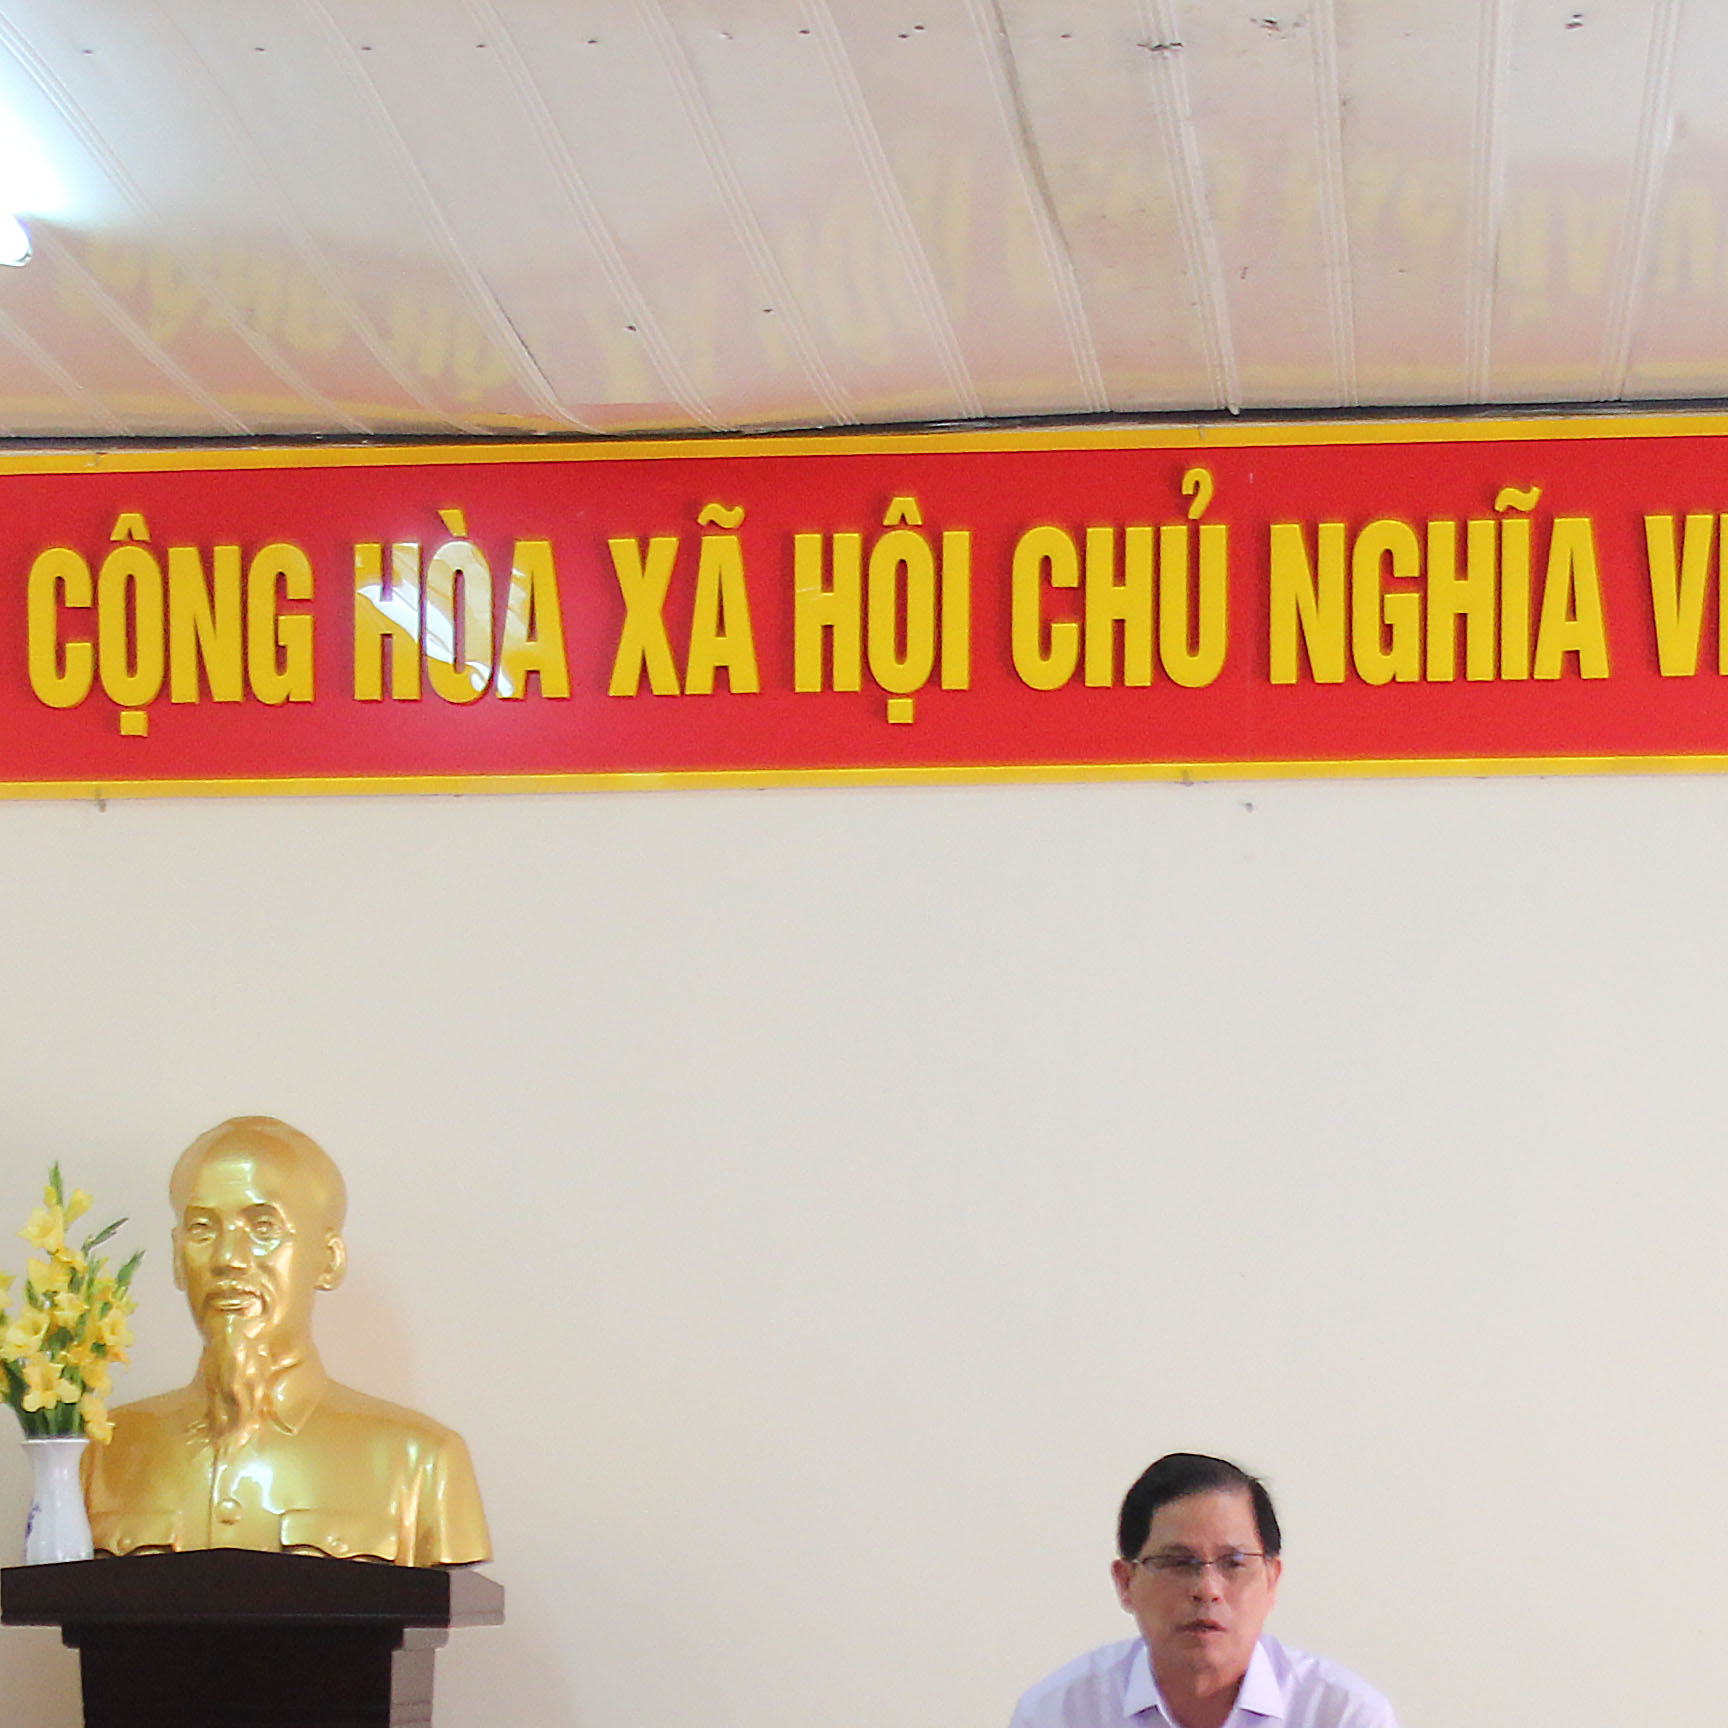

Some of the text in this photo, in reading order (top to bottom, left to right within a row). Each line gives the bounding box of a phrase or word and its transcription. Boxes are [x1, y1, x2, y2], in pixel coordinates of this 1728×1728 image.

[26, 511, 315, 738] CỘNG
[352, 507, 572, 702] HÒA
[606, 501, 761, 698] XÃ
[793, 495, 973, 725] HỘI
[1010, 466, 1231, 692] CHỦ
[1268, 484, 1612, 687] NGHĨA
